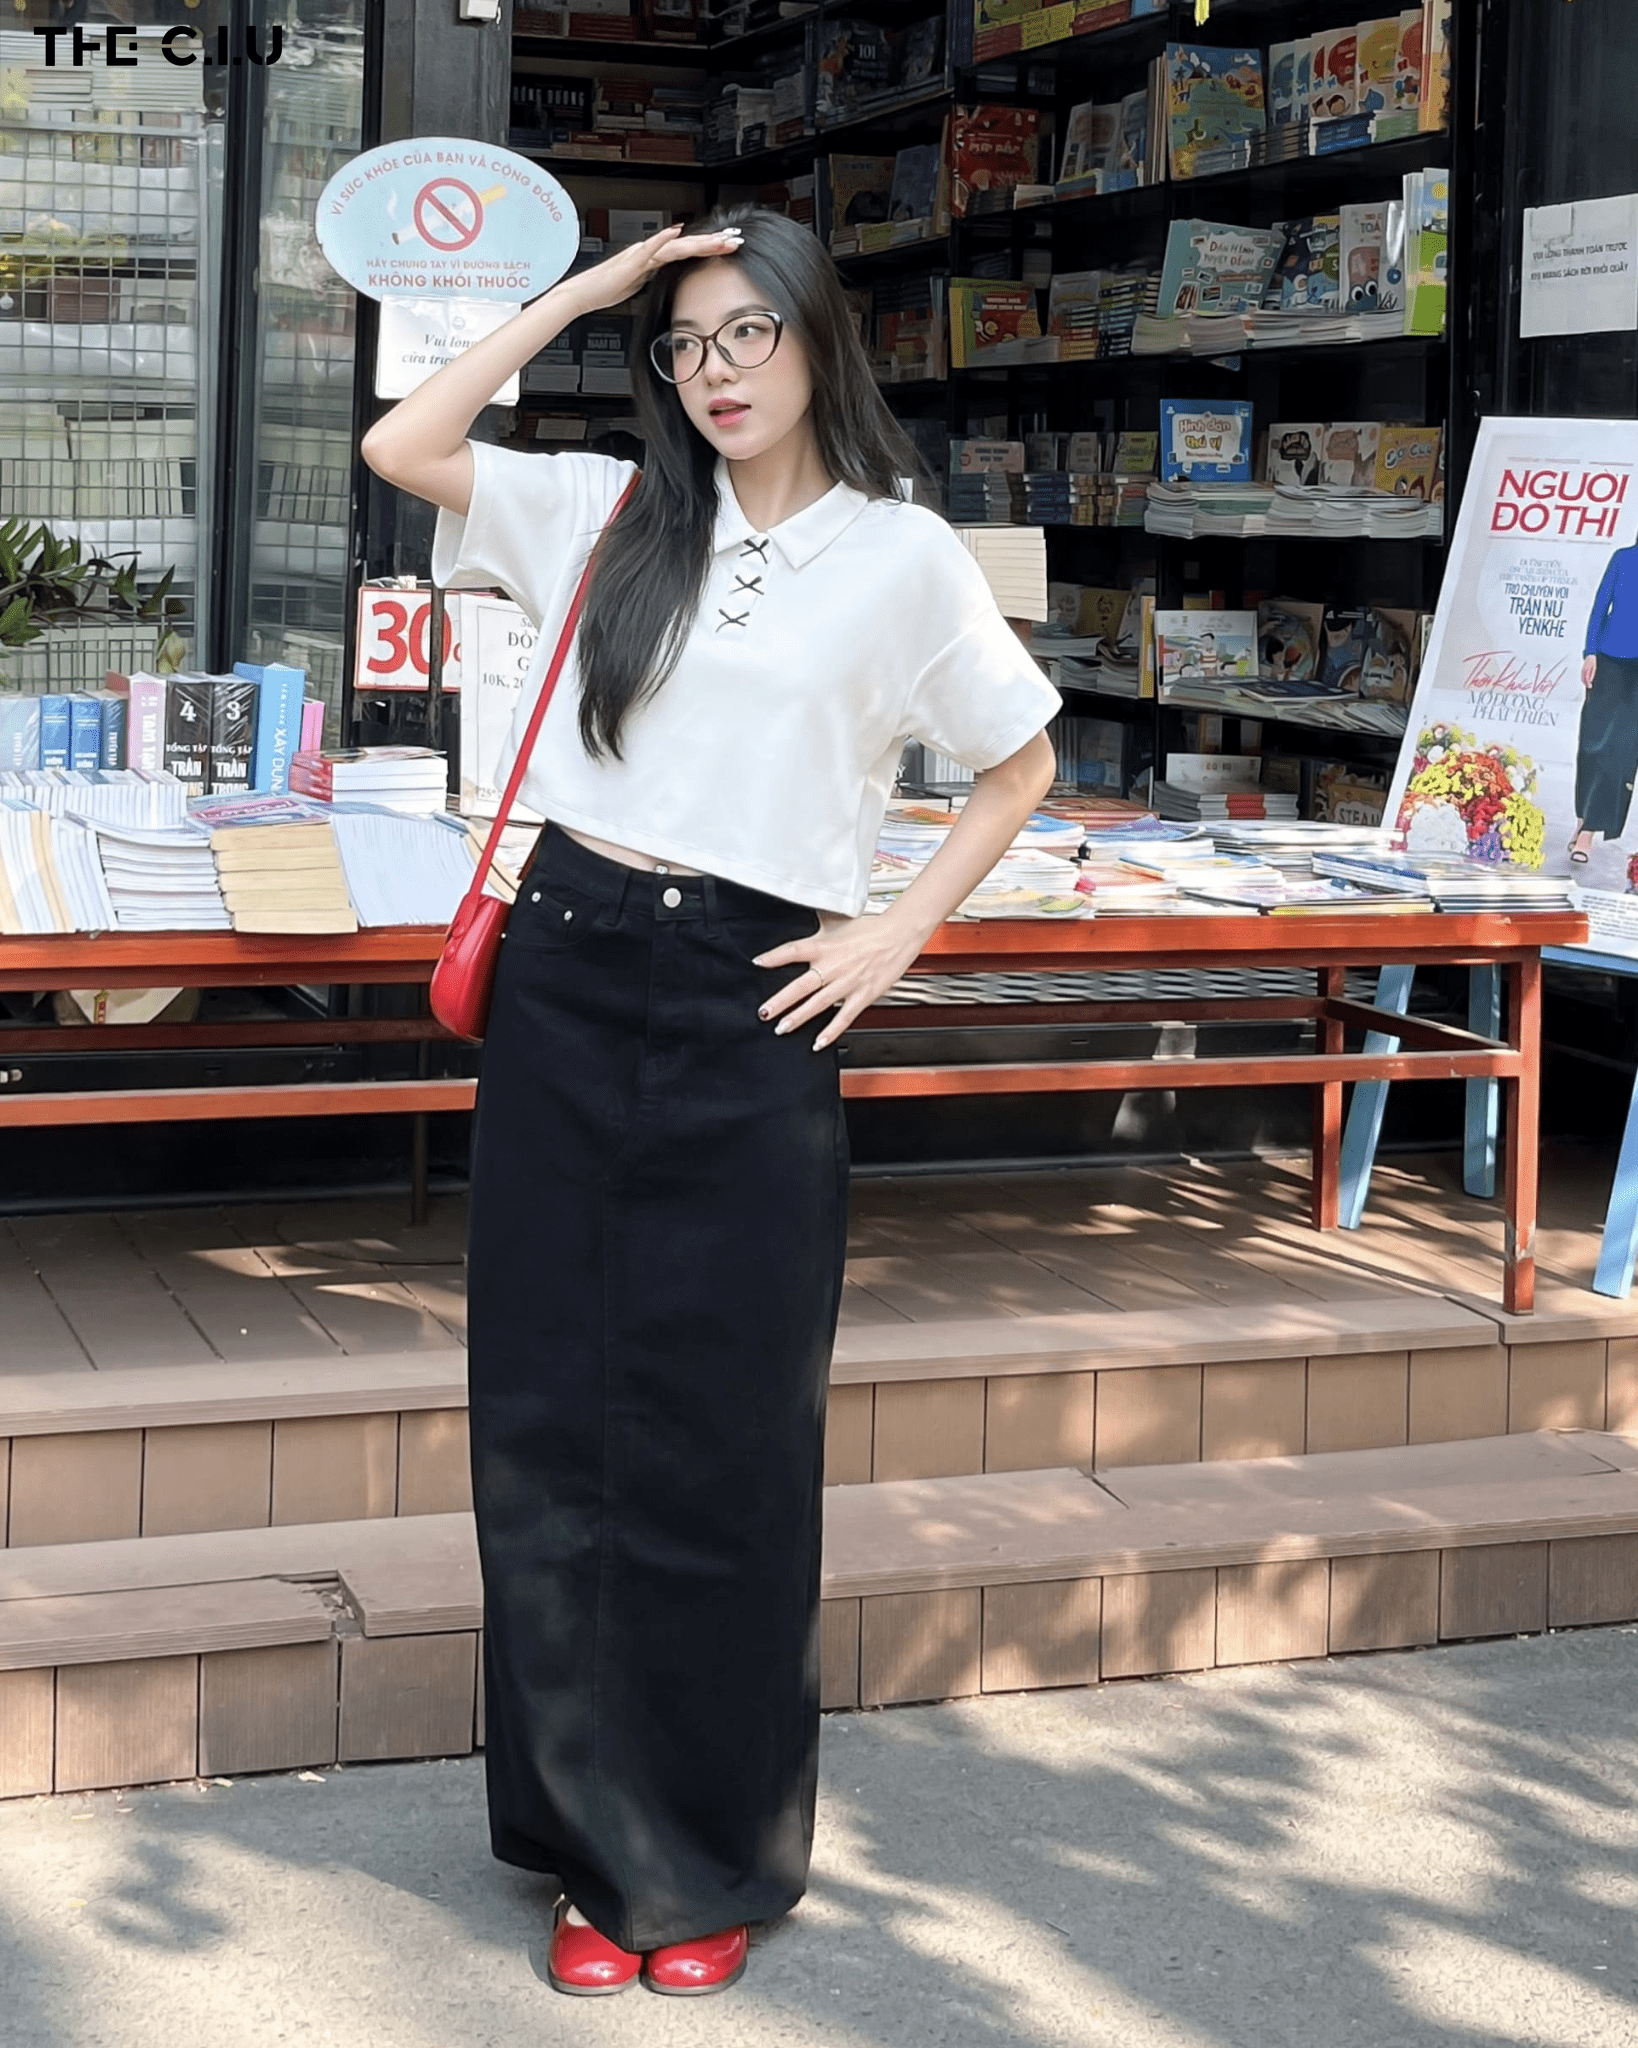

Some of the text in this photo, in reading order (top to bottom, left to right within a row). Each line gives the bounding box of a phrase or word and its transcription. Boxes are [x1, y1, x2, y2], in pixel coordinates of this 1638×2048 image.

[436, 152, 464, 168] BẠN
[390, 259, 428, 270] CHUNG
[430, 260, 448, 270] TAY
[368, 269, 531, 288] KHÔNG KHÓI THUỐC
[366, 600, 461, 674] 30
[179, 701, 197, 722] 4
[226, 701, 241, 721] 3
